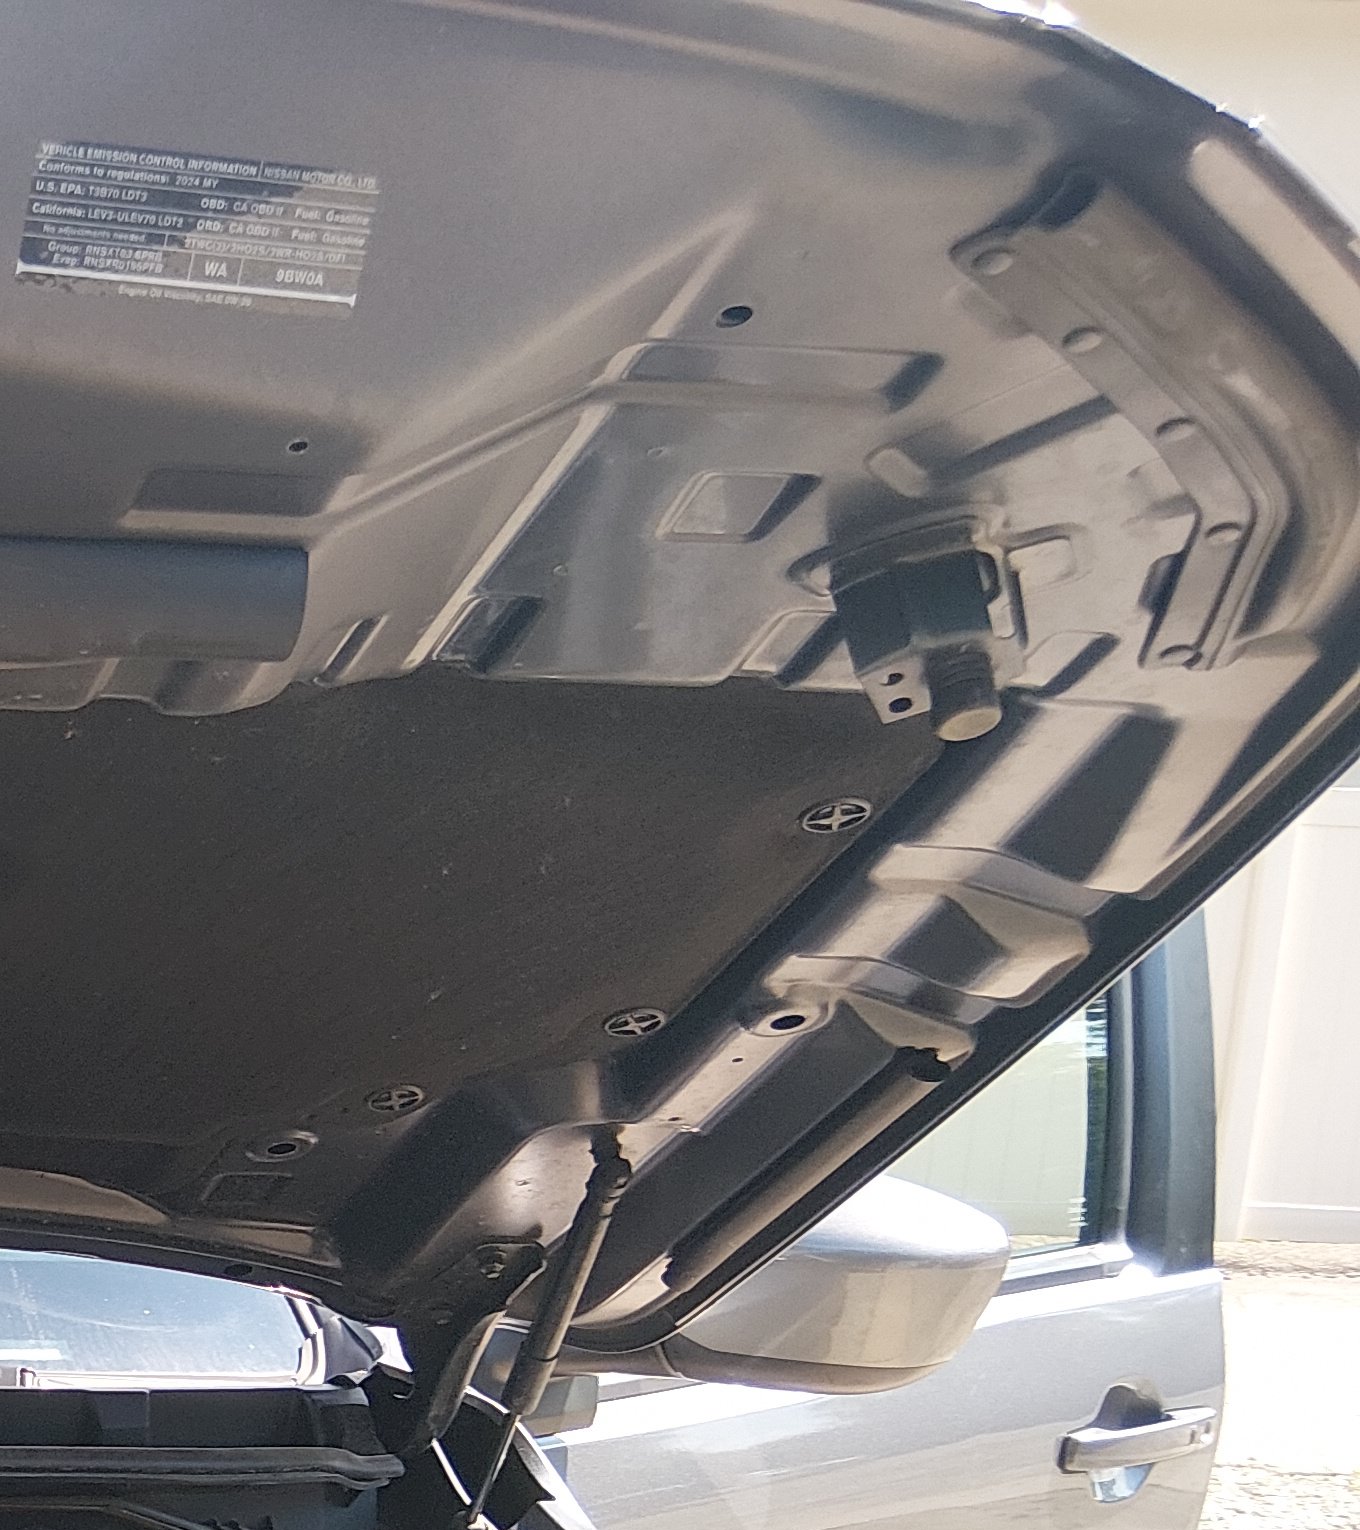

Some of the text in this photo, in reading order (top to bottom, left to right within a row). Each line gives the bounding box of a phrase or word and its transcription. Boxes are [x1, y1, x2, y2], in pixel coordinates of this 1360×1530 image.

[38, 160, 91, 175] Conforms
[93, 166, 105, 177] to
[175, 175, 200, 187] 2024
[202, 178, 219, 189] MY
[42, 143, 85, 158] VEHICLE
[86, 146, 137, 163] EMISSION
[139, 153, 186, 169] CONTROL
[187, 159, 258, 177] INFORMATION
[264, 166, 300, 181] NISSAN
[32, 202, 86, 218] California:
[59, 182, 85, 195] EPA:
[200, 197, 228, 211] OBD:
[233, 201, 248, 213] CA
[204, 260, 228, 278] WA
